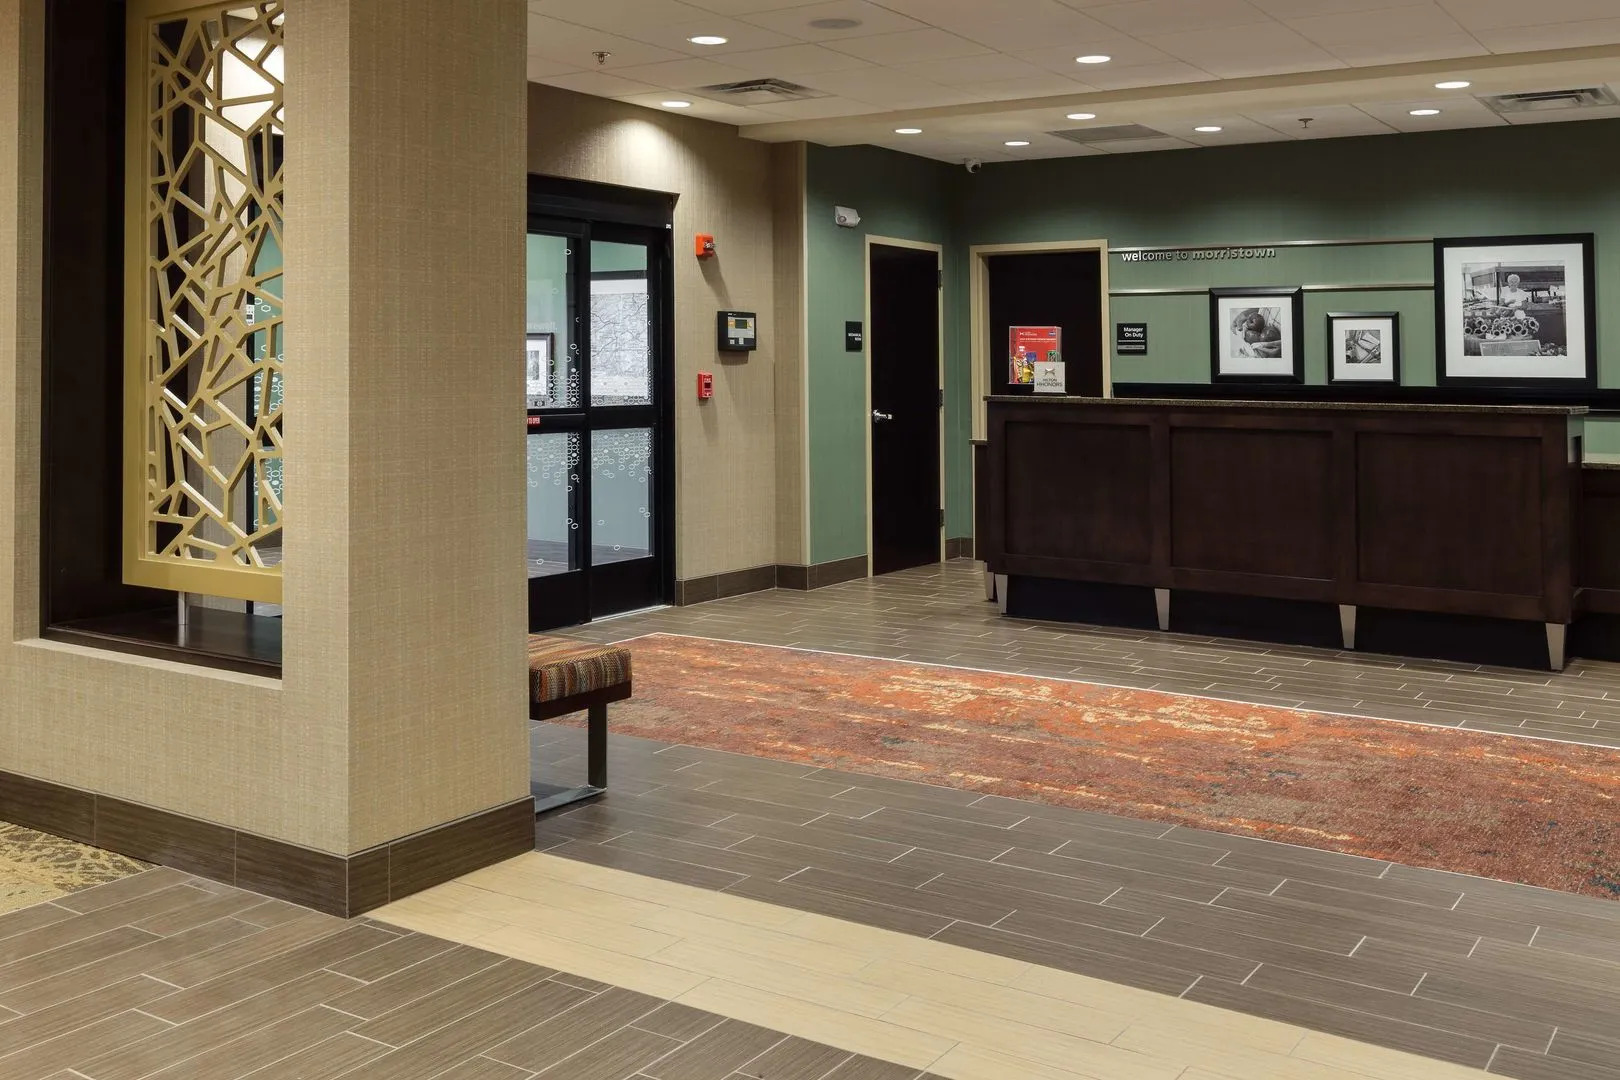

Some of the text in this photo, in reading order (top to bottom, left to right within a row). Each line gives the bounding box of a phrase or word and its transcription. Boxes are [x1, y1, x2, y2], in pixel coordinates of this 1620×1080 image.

[1121, 247, 1276, 261] welcome to morristown
